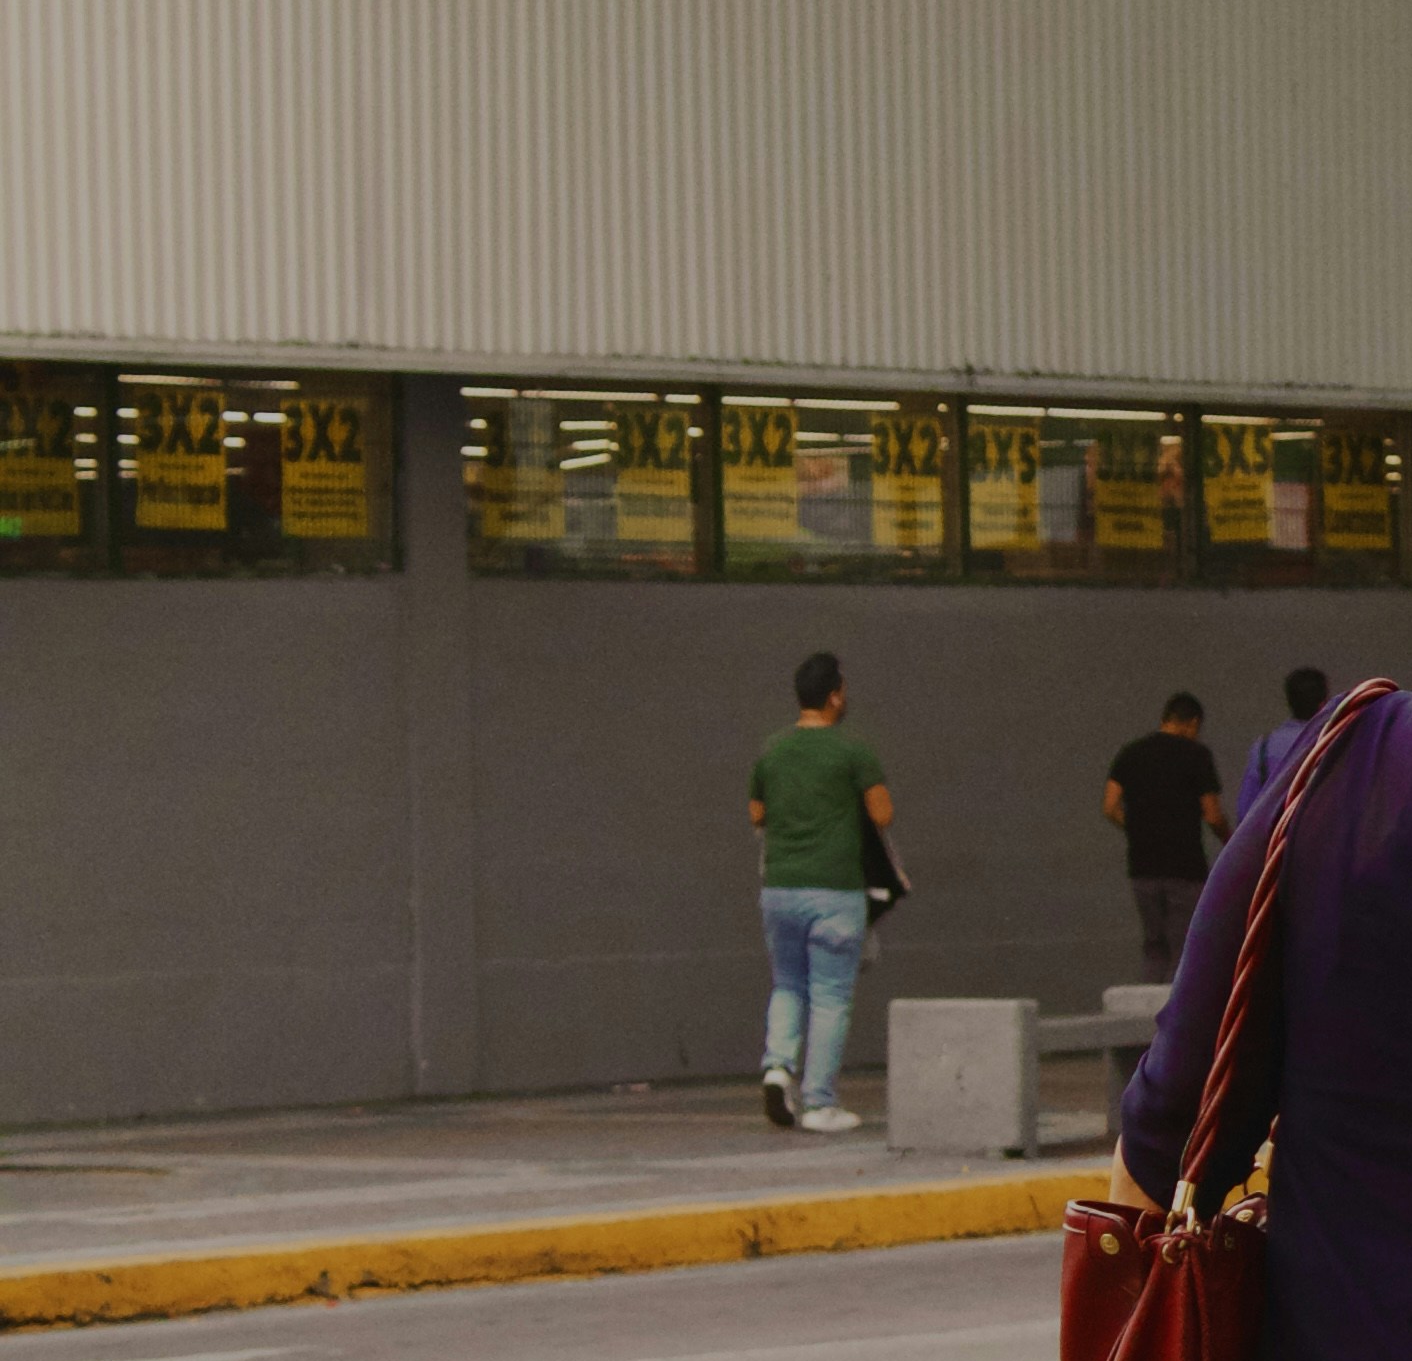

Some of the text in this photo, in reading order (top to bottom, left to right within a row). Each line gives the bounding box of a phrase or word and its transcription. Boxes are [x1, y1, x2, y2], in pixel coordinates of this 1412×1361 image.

[139, 392, 220, 455] 3X2
[284, 403, 363, 464] 3X2
[722, 411, 792, 467] 3X2
[874, 421, 941, 475] 3X2
